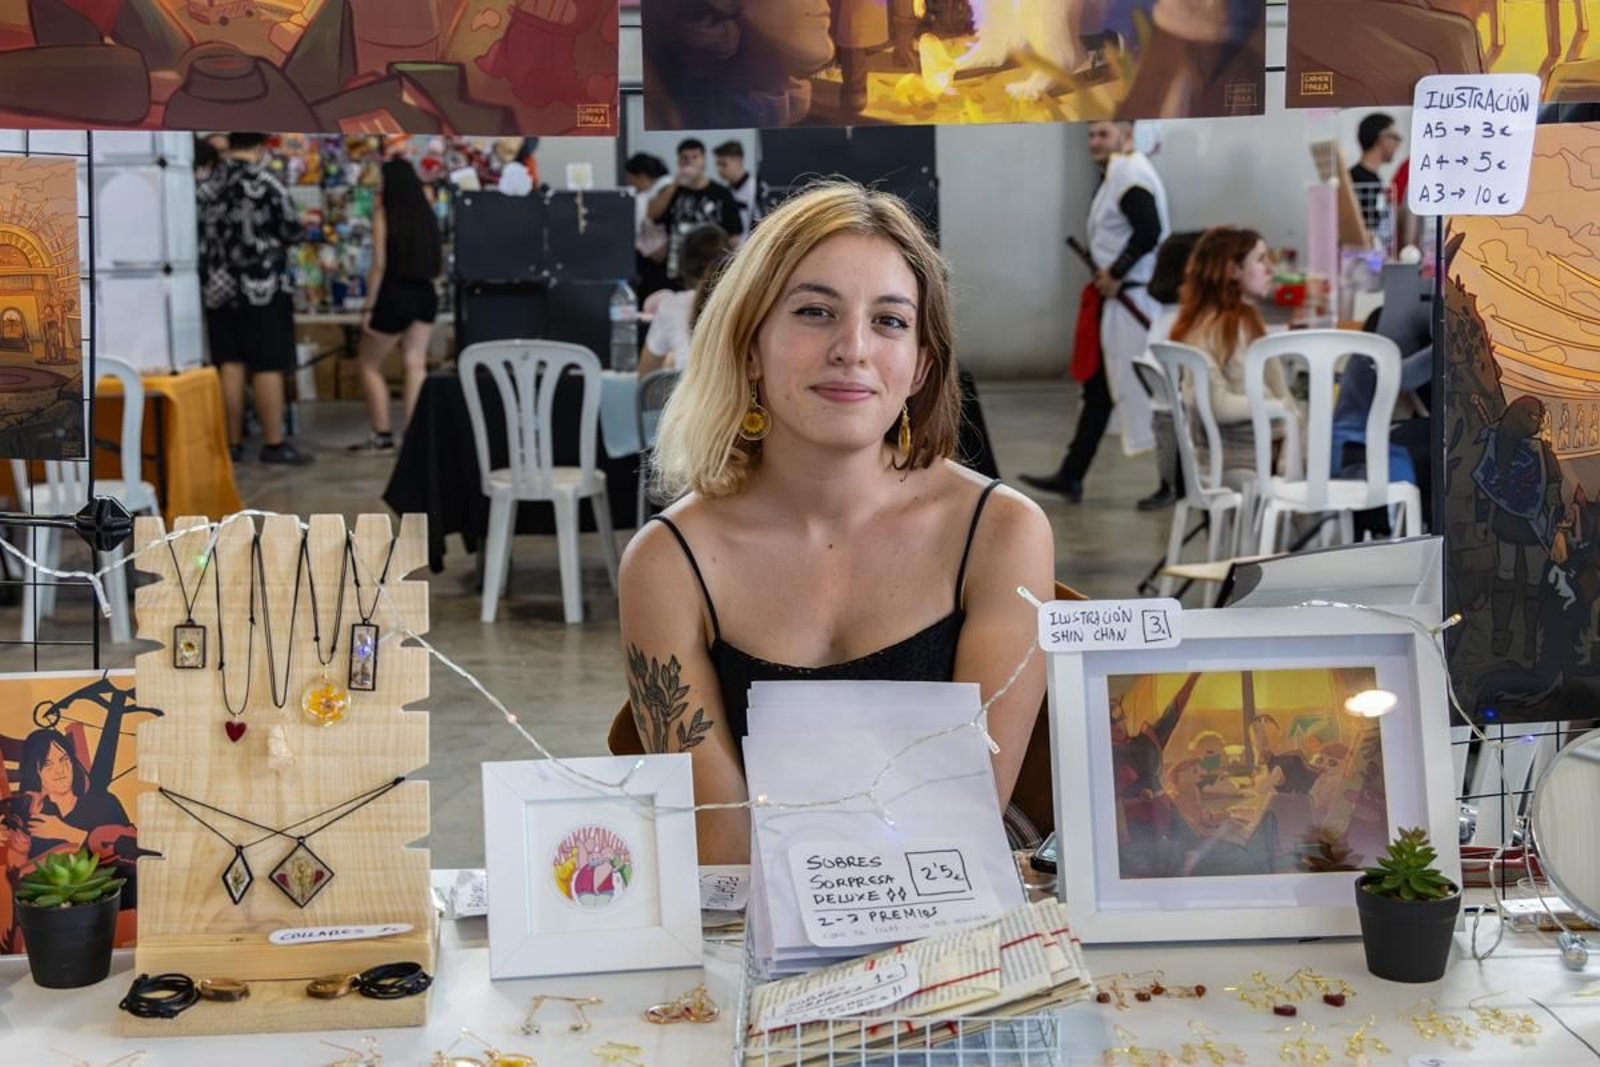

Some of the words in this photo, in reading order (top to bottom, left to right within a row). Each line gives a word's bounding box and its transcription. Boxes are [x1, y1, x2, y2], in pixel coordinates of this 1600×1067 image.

[1424, 86, 1530, 113] ILUSTRACIÓN
[1422, 121, 1448, 139] A5
[1420, 153, 1450, 171] A4
[1419, 183, 1446, 204] A3
[1050, 629, 1084, 644] SHIN
[1093, 627, 1127, 642] CHAN
[809, 873, 895, 891] SORPRESA
[812, 890, 882, 905] DELUXE
[868, 906, 939, 923] PREMIOS
